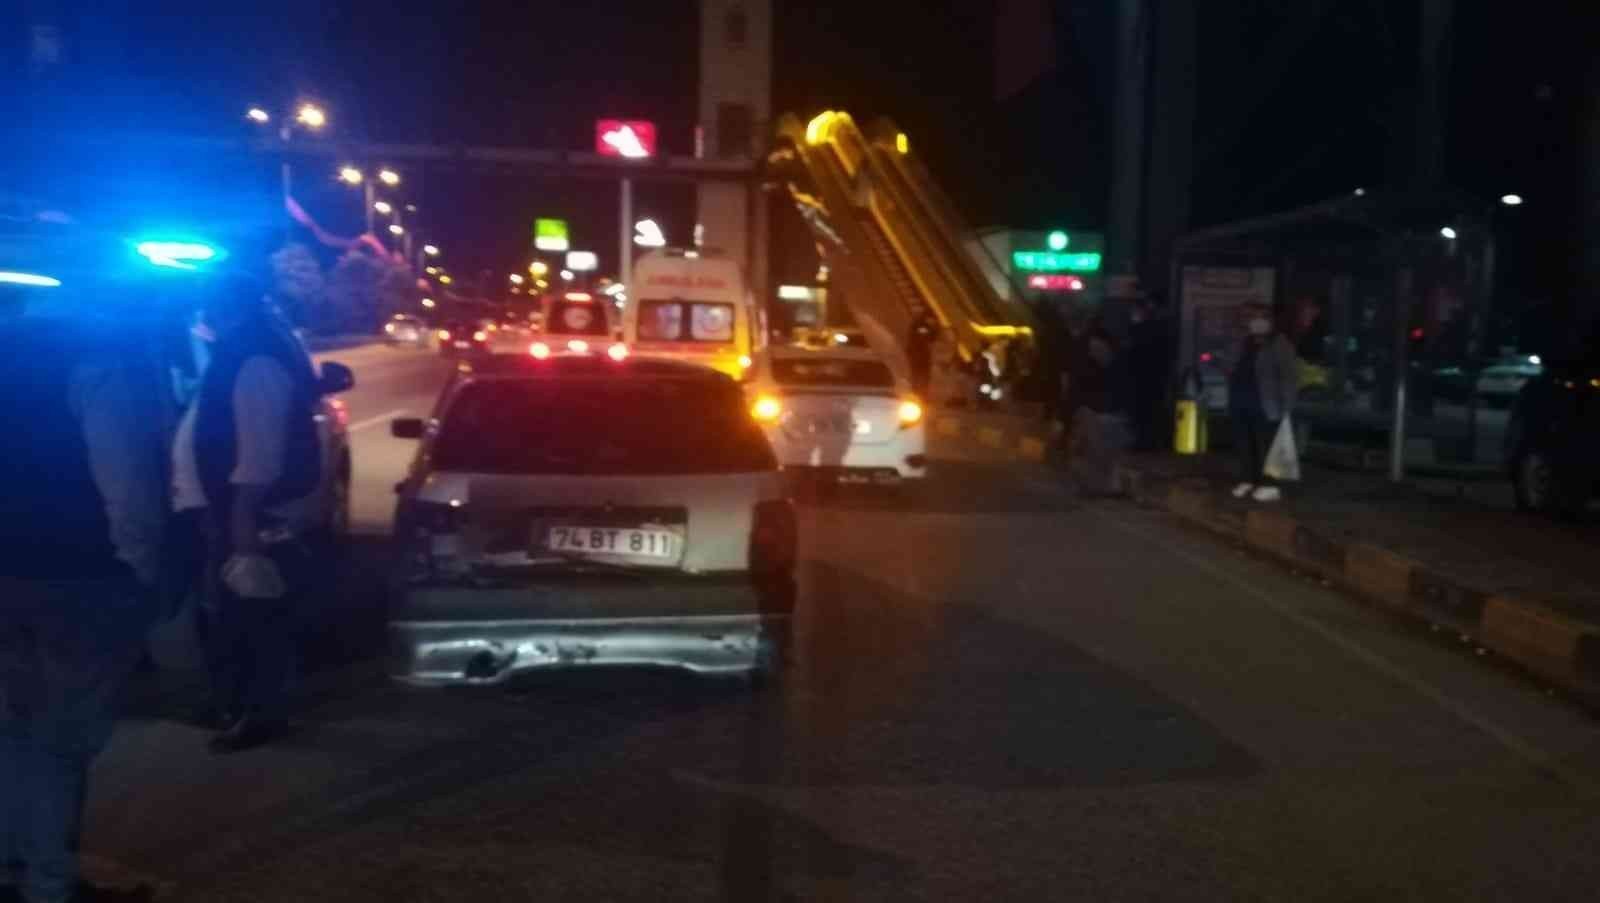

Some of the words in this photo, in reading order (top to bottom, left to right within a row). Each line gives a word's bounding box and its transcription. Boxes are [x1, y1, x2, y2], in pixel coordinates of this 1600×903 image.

[554, 528, 584, 547] 74
[590, 529, 619, 549] BT
[629, 531, 669, 553] 811
